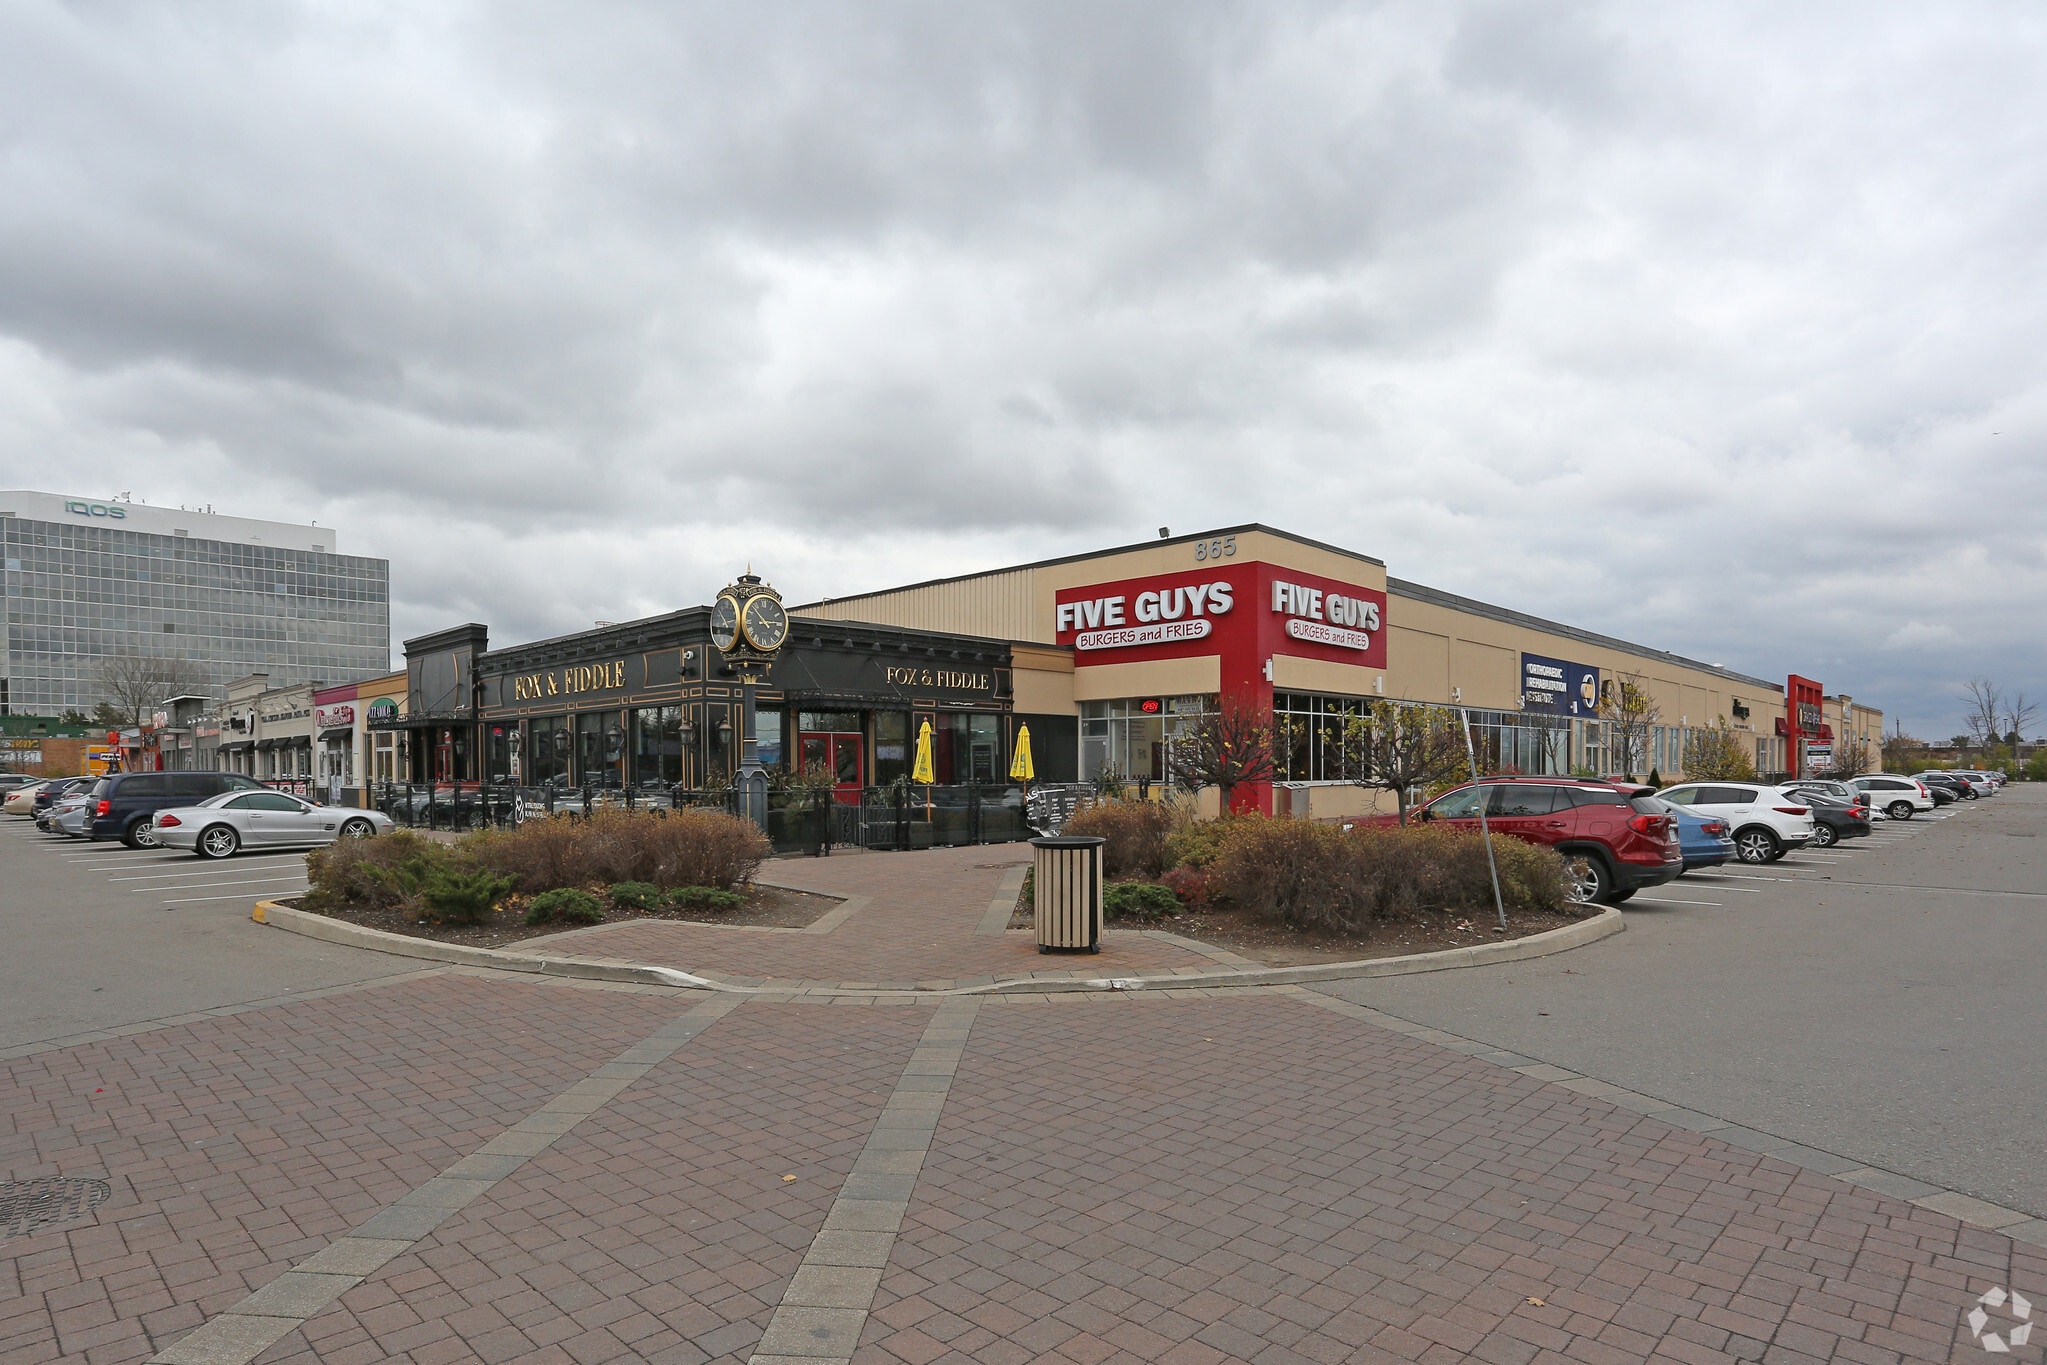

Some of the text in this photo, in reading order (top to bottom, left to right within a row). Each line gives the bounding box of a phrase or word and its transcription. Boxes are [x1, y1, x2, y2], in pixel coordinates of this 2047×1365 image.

[1195, 535, 1236, 561] 865
[1057, 582, 1234, 632] FIVE GUYS
[1272, 580, 1379, 631] FIVE GUYS
[1080, 622, 1203, 647] BURGERS and FRIES
[1293, 622, 1366, 647] BURGERS and FRIES
[515, 661, 626, 700] FOX & FIDDLE
[887, 667, 989, 690] FOX & FIDDLE
[1526, 663, 1562, 679] ORTHOPAEDIC
